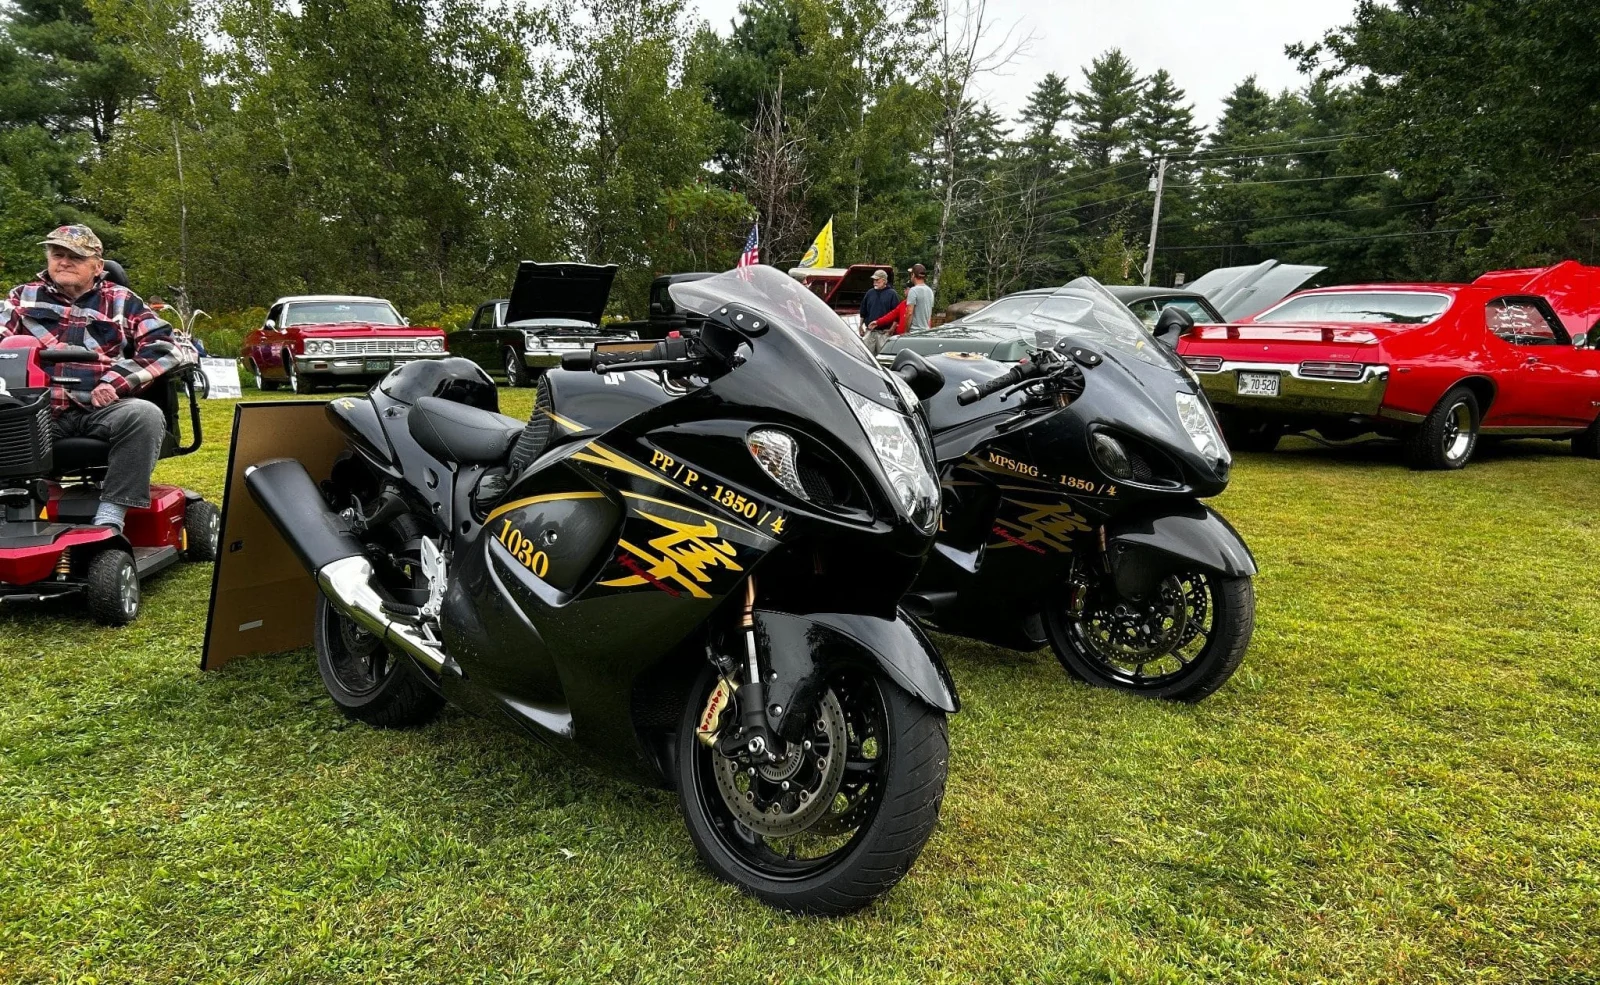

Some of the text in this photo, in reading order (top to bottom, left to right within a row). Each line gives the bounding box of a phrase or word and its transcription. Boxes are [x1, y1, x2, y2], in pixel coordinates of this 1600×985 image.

[989, 452, 1038, 478] MPS/BG
[1059, 474, 1095, 492] 1350
[711, 484, 758, 519] 1350
[499, 518, 549, 579] 1030
[701, 690, 723, 731] brembo
